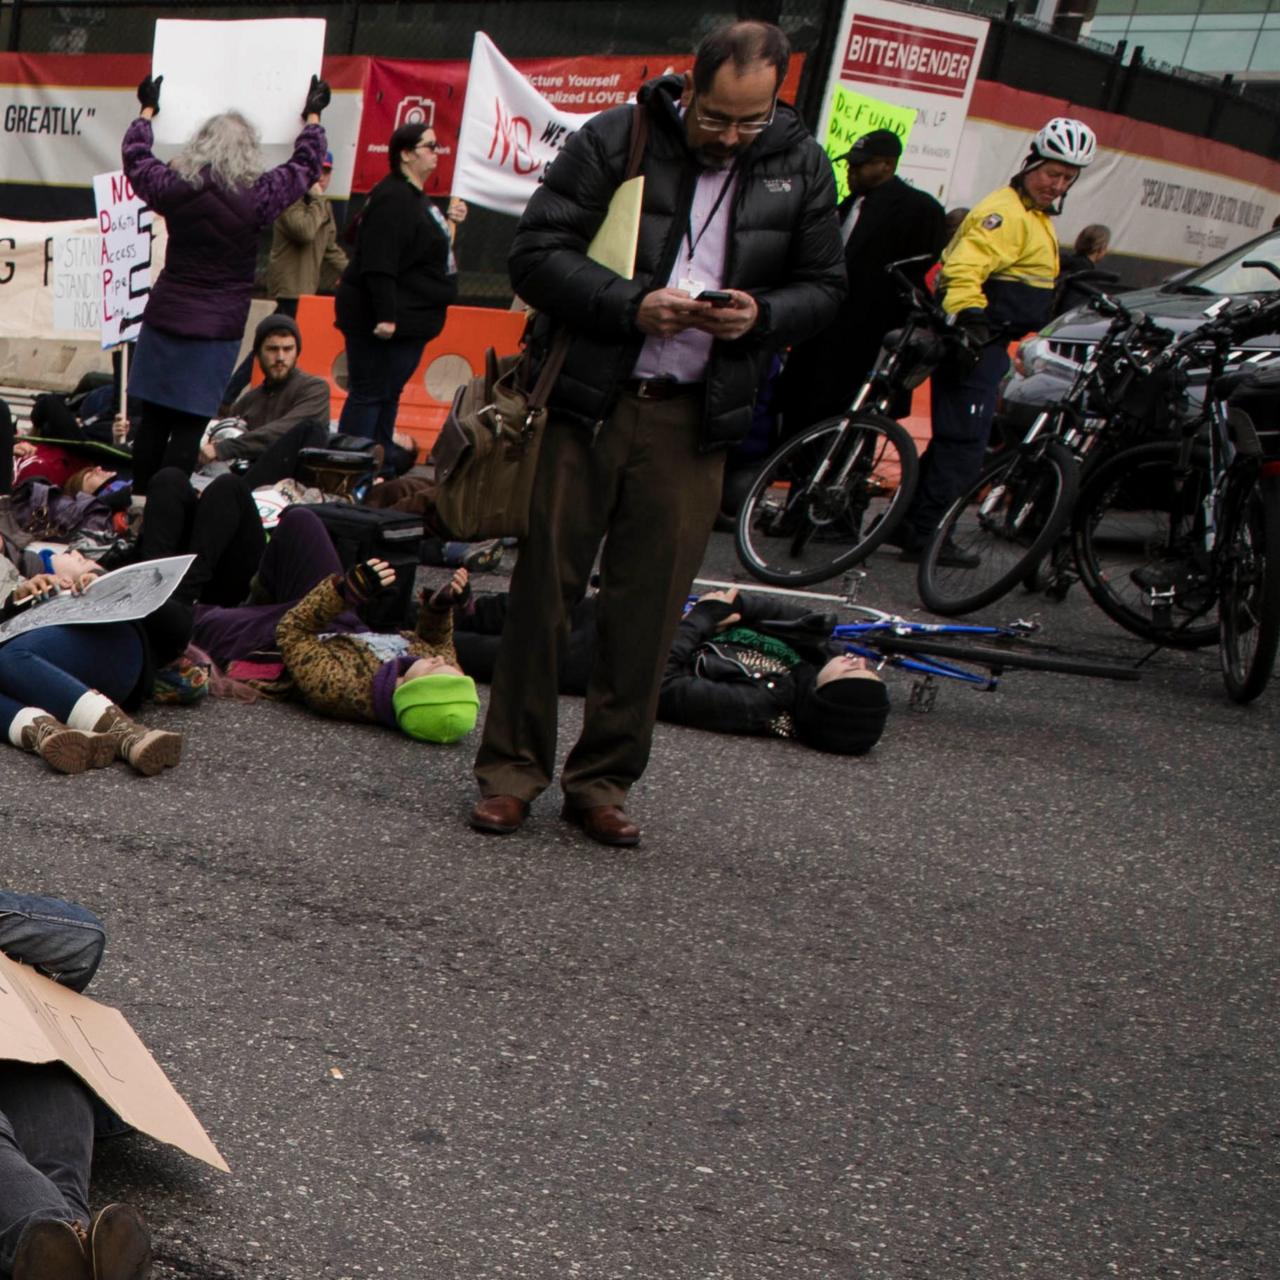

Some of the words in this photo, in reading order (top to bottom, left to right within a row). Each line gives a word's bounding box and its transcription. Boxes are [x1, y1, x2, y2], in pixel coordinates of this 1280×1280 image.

[848, 34, 970, 80] BITTENBENDER
[525, 75, 564, 87] icture
[568, 74, 620, 87] Yourself
[587, 91, 625, 105] LOVE
[829, 118, 857, 144] DAK
